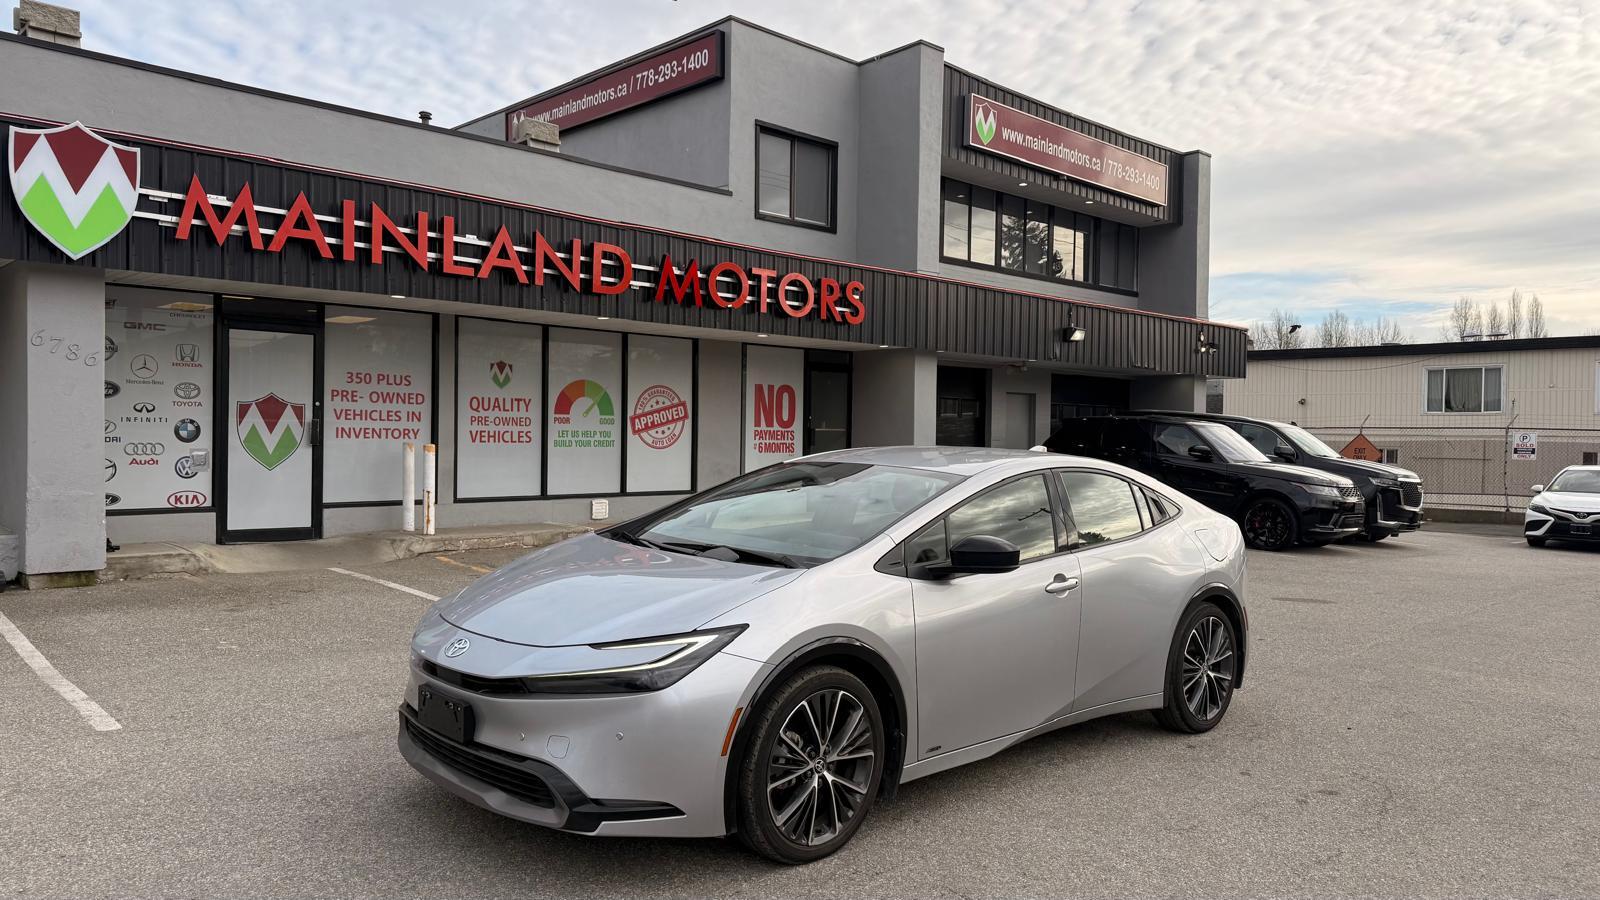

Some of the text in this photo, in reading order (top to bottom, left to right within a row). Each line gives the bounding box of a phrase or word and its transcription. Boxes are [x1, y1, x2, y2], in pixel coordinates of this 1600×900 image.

[636, 49, 709, 91] 778-293-1400
[1001, 125, 1101, 171] www.mainlandmotors.ca
[1108, 159, 1160, 191] 778-293-1400
[175, 173, 866, 326] MAINLAND MOTORS
[123, 321, 167, 331] GMC
[30, 329, 99, 367] 6786
[346, 371, 412, 387] 350 PLUS
[330, 389, 425, 405] PRE- OWNED
[172, 400, 203, 408] TOYOTA
[469, 396, 532, 413] QUALITY
[753, 383, 796, 429] NO
[333, 408, 422, 422] VEHICLES IN
[470, 415, 532, 427] PRE-OWNED
[553, 416, 615, 425] POOR GOOD
[634, 405, 685, 431] APPROVED
[335, 427, 420, 440] INVENTORY
[469, 430, 532, 443] VEHICLES
[557, 430, 611, 439] LET US HELP YOU
[651, 432, 677, 447] AUTO LOAN
[753, 429, 795, 442] PAYMENTS
[553, 439, 615, 448] BUILD YOUR CREDIT
[758, 442, 764, 454] 6
[763, 442, 795, 454] MONTHS
[128, 457, 159, 466] Audi
[174, 494, 201, 505] KIA
